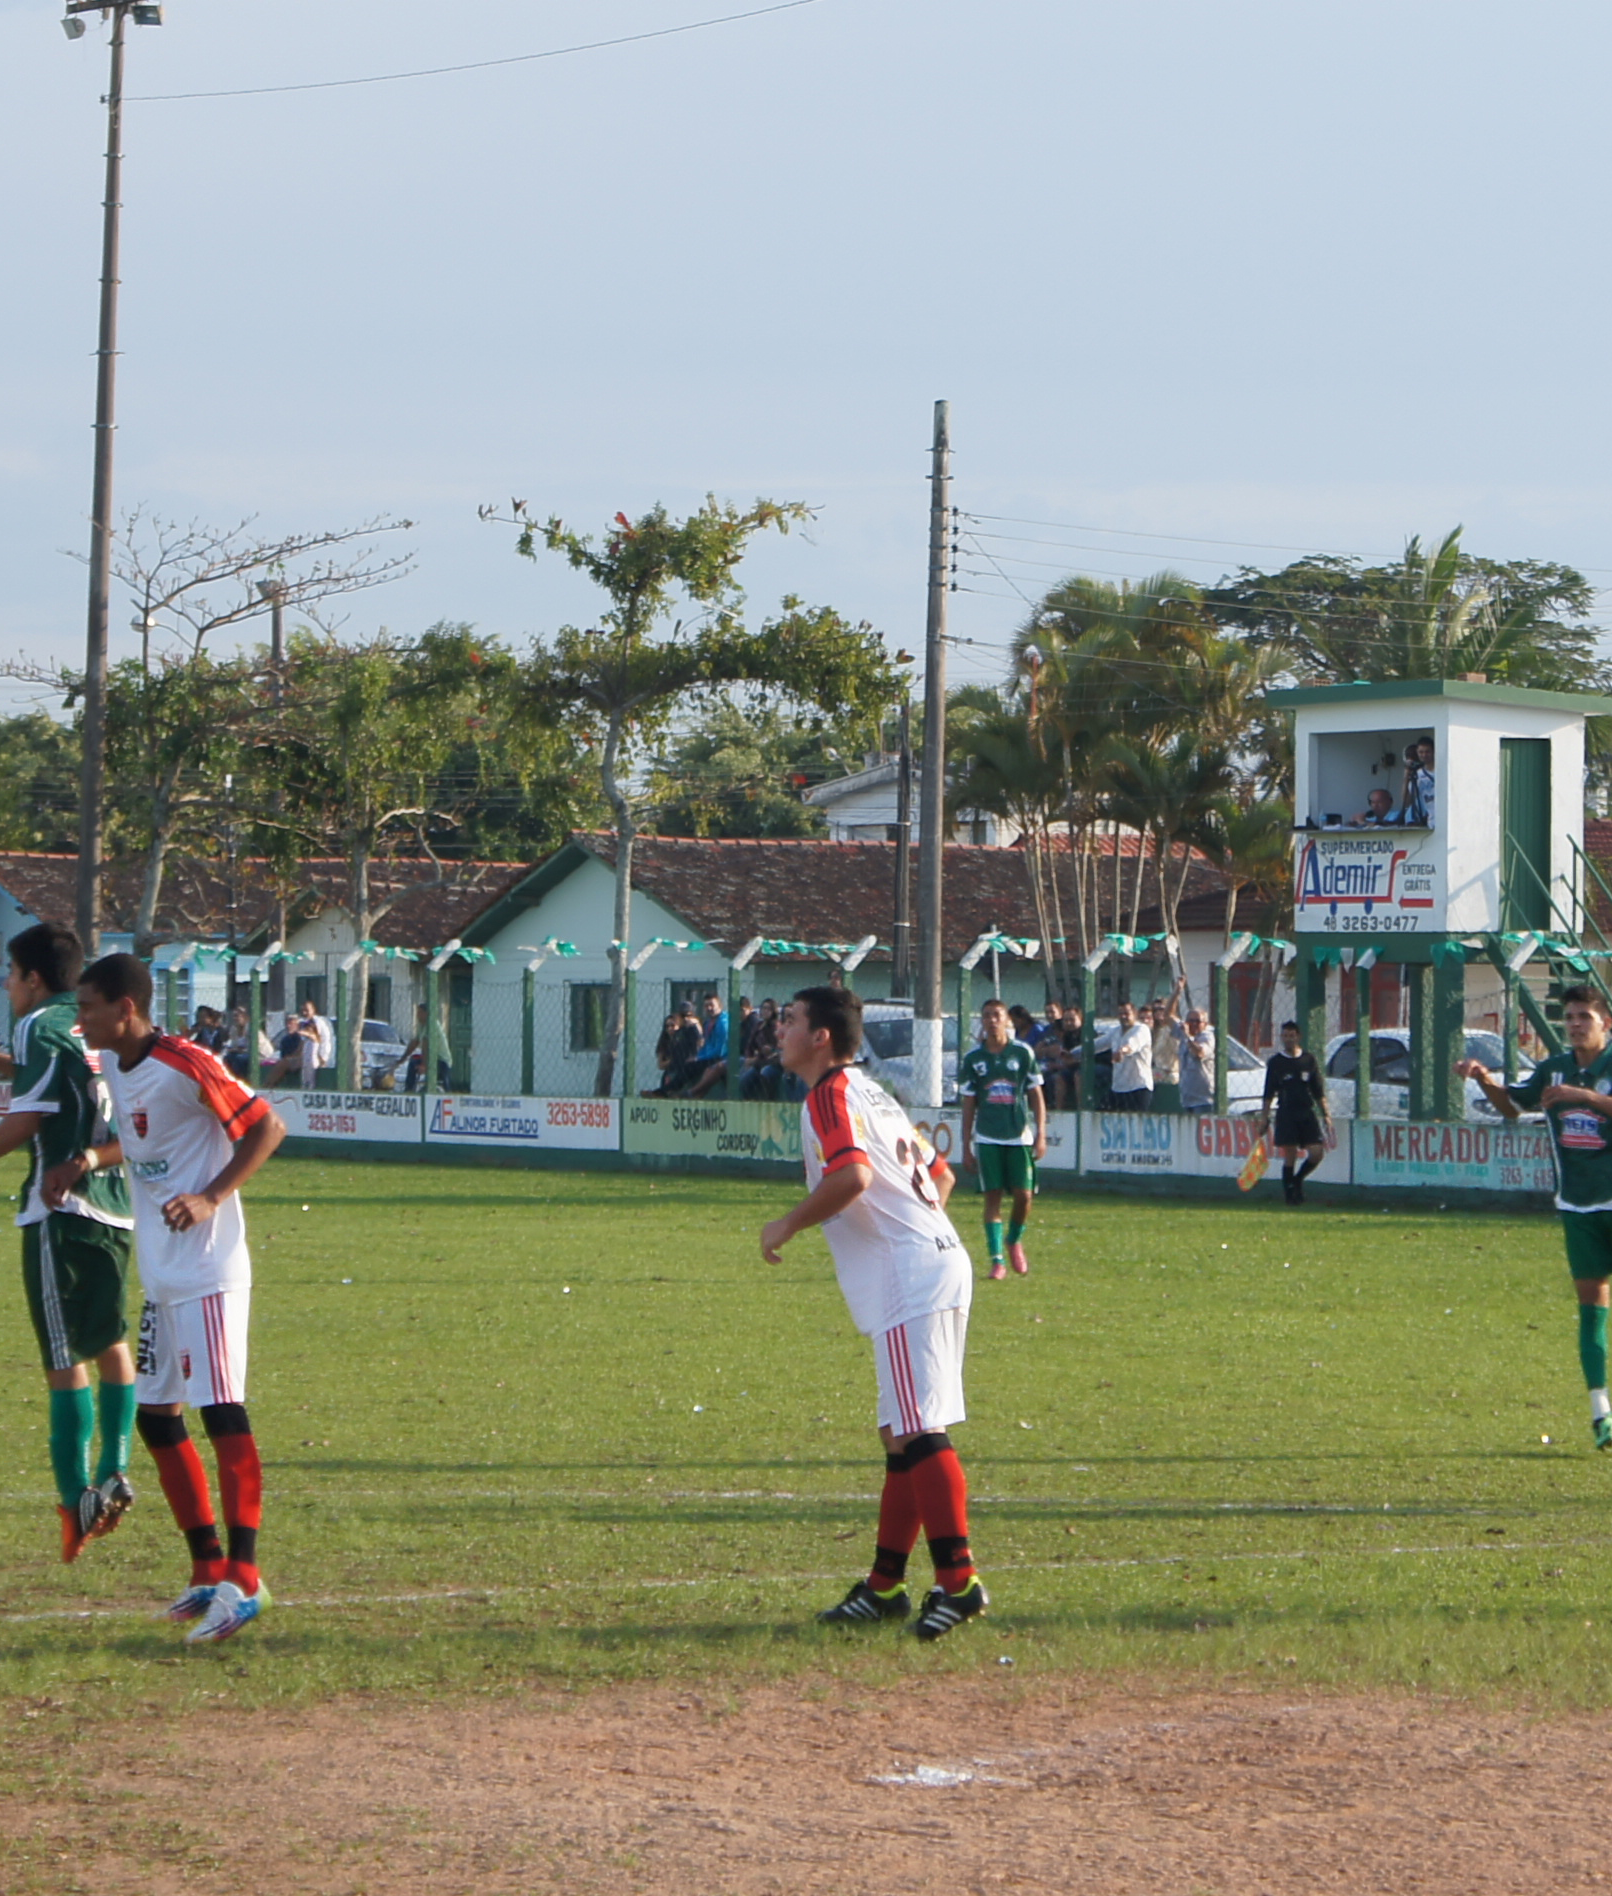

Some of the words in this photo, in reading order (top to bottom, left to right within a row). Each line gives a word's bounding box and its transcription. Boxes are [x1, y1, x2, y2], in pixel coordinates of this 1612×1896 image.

[1320, 839, 1395, 854] SUPERMERCADO
[1299, 840, 1383, 912] Ademir
[1402, 863, 1436, 876] ENTREGA
[1342, 916, 1419, 931] 3263-0477
[302, 1094, 328, 1109] CASA
[330, 1094, 343, 1110] DA
[345, 1095, 375, 1112] CARNE
[374, 1097, 417, 1118] GERALDO
[546, 1102, 610, 1128] 3263-5898
[451, 1115, 487, 1132] ALINOR
[491, 1117, 538, 1134] FURTADO
[672, 1107, 727, 1138] SERGINHO
[717, 1133, 760, 1156] CORDEIRO
[1373, 1124, 1489, 1164] MERCADO
